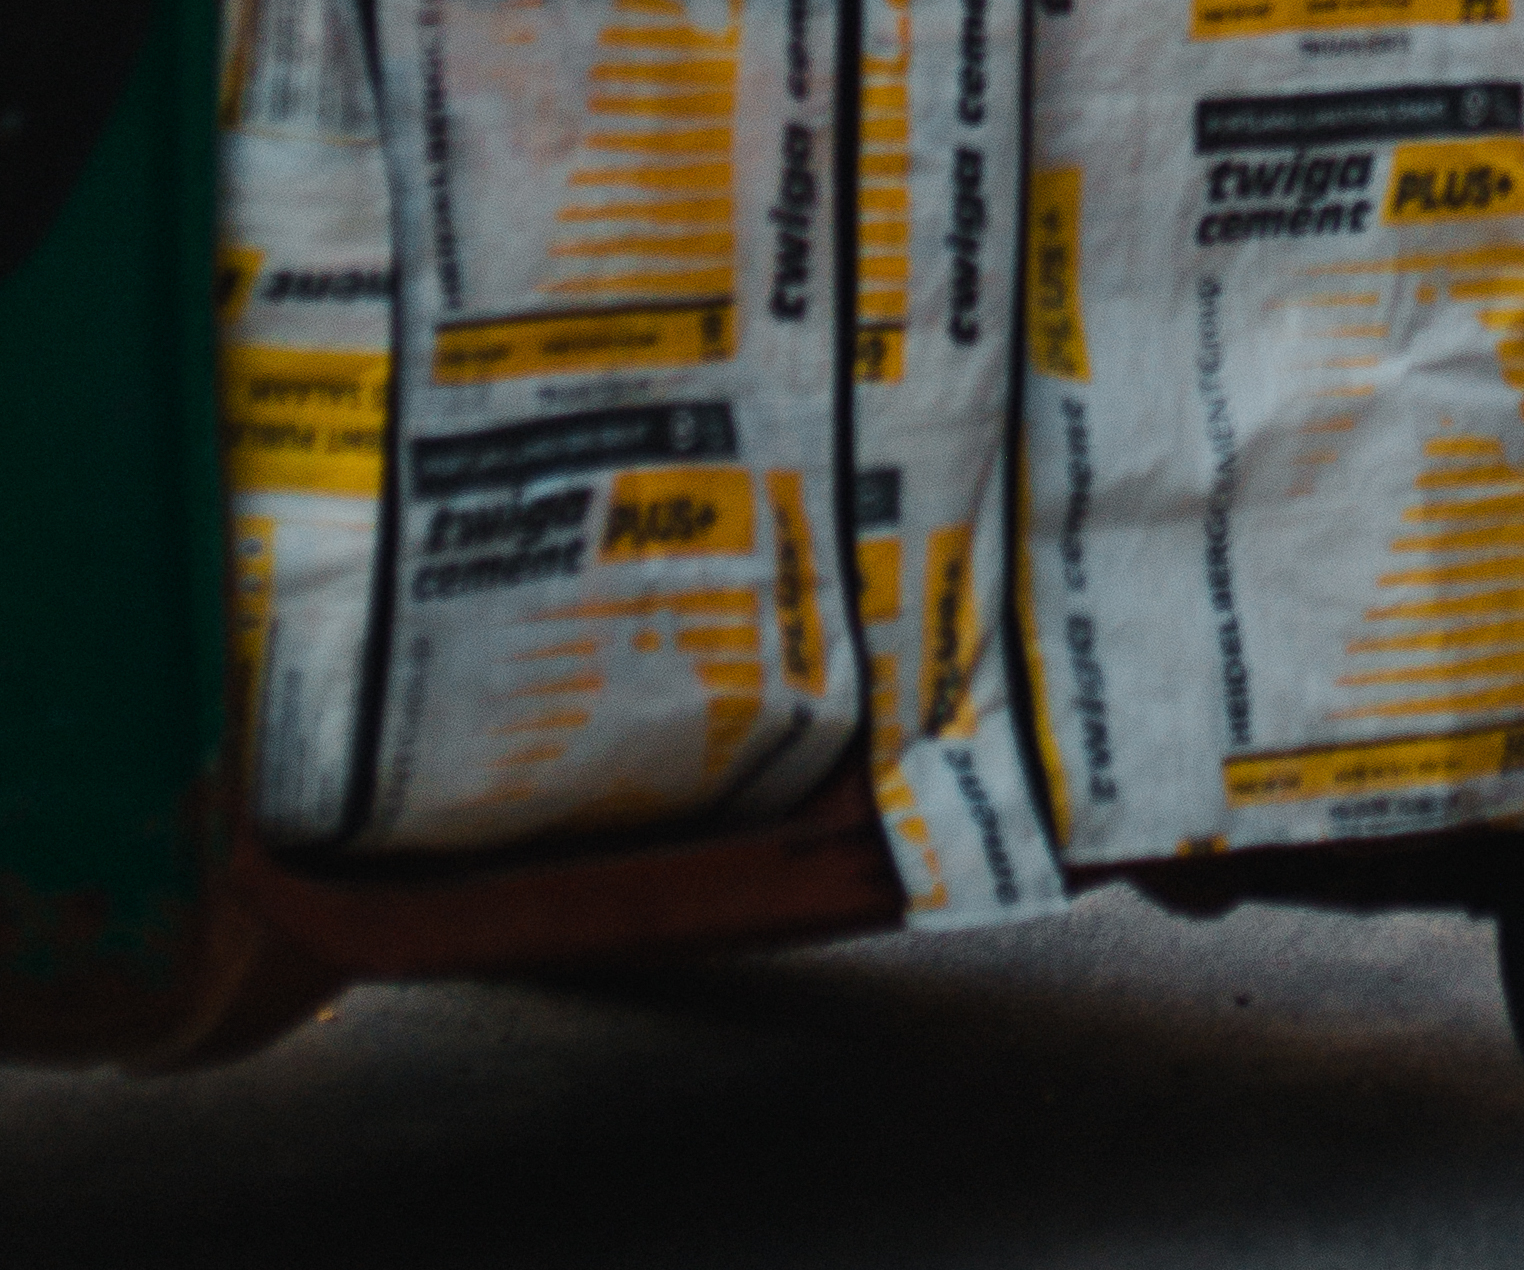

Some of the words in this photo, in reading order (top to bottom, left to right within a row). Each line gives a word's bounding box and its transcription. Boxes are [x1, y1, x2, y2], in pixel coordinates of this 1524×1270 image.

[1196, 198, 1373, 246] cement
[1391, 159, 1514, 215] PLUS+
[1208, 147, 1376, 205] twiga
[944, 143, 989, 348] twiga
